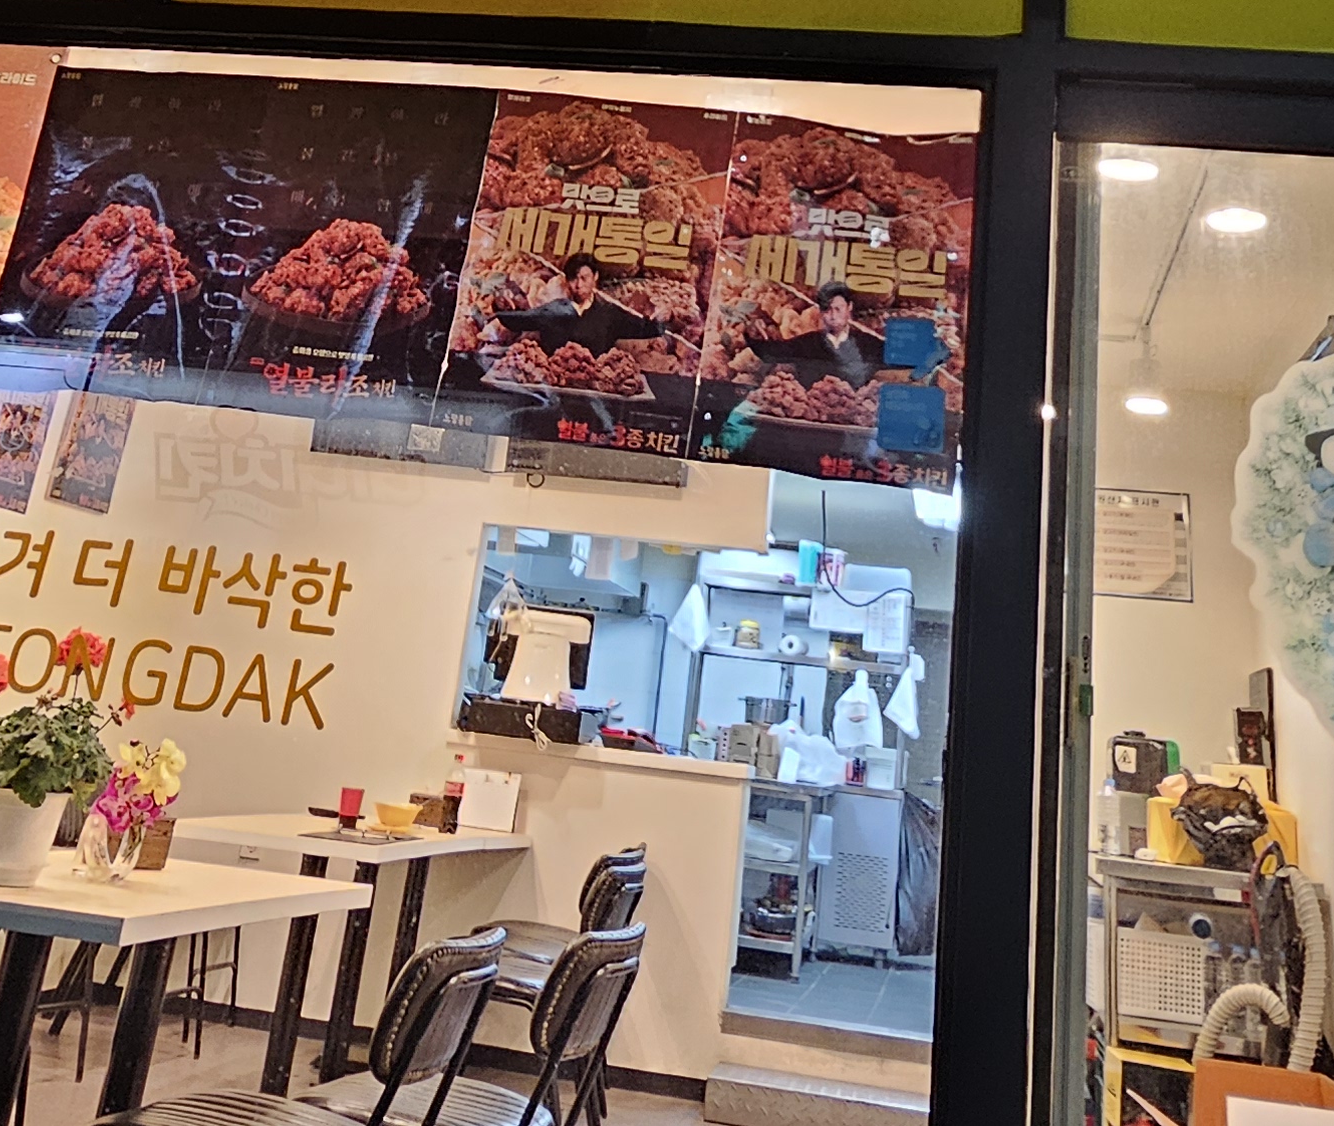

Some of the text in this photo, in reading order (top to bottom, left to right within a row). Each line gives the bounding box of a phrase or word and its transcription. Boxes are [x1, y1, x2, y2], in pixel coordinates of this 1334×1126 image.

[561, 182, 641, 216] 맛으로
[72, 537, 136, 608] 더
[157, 544, 354, 637] 바삭한
